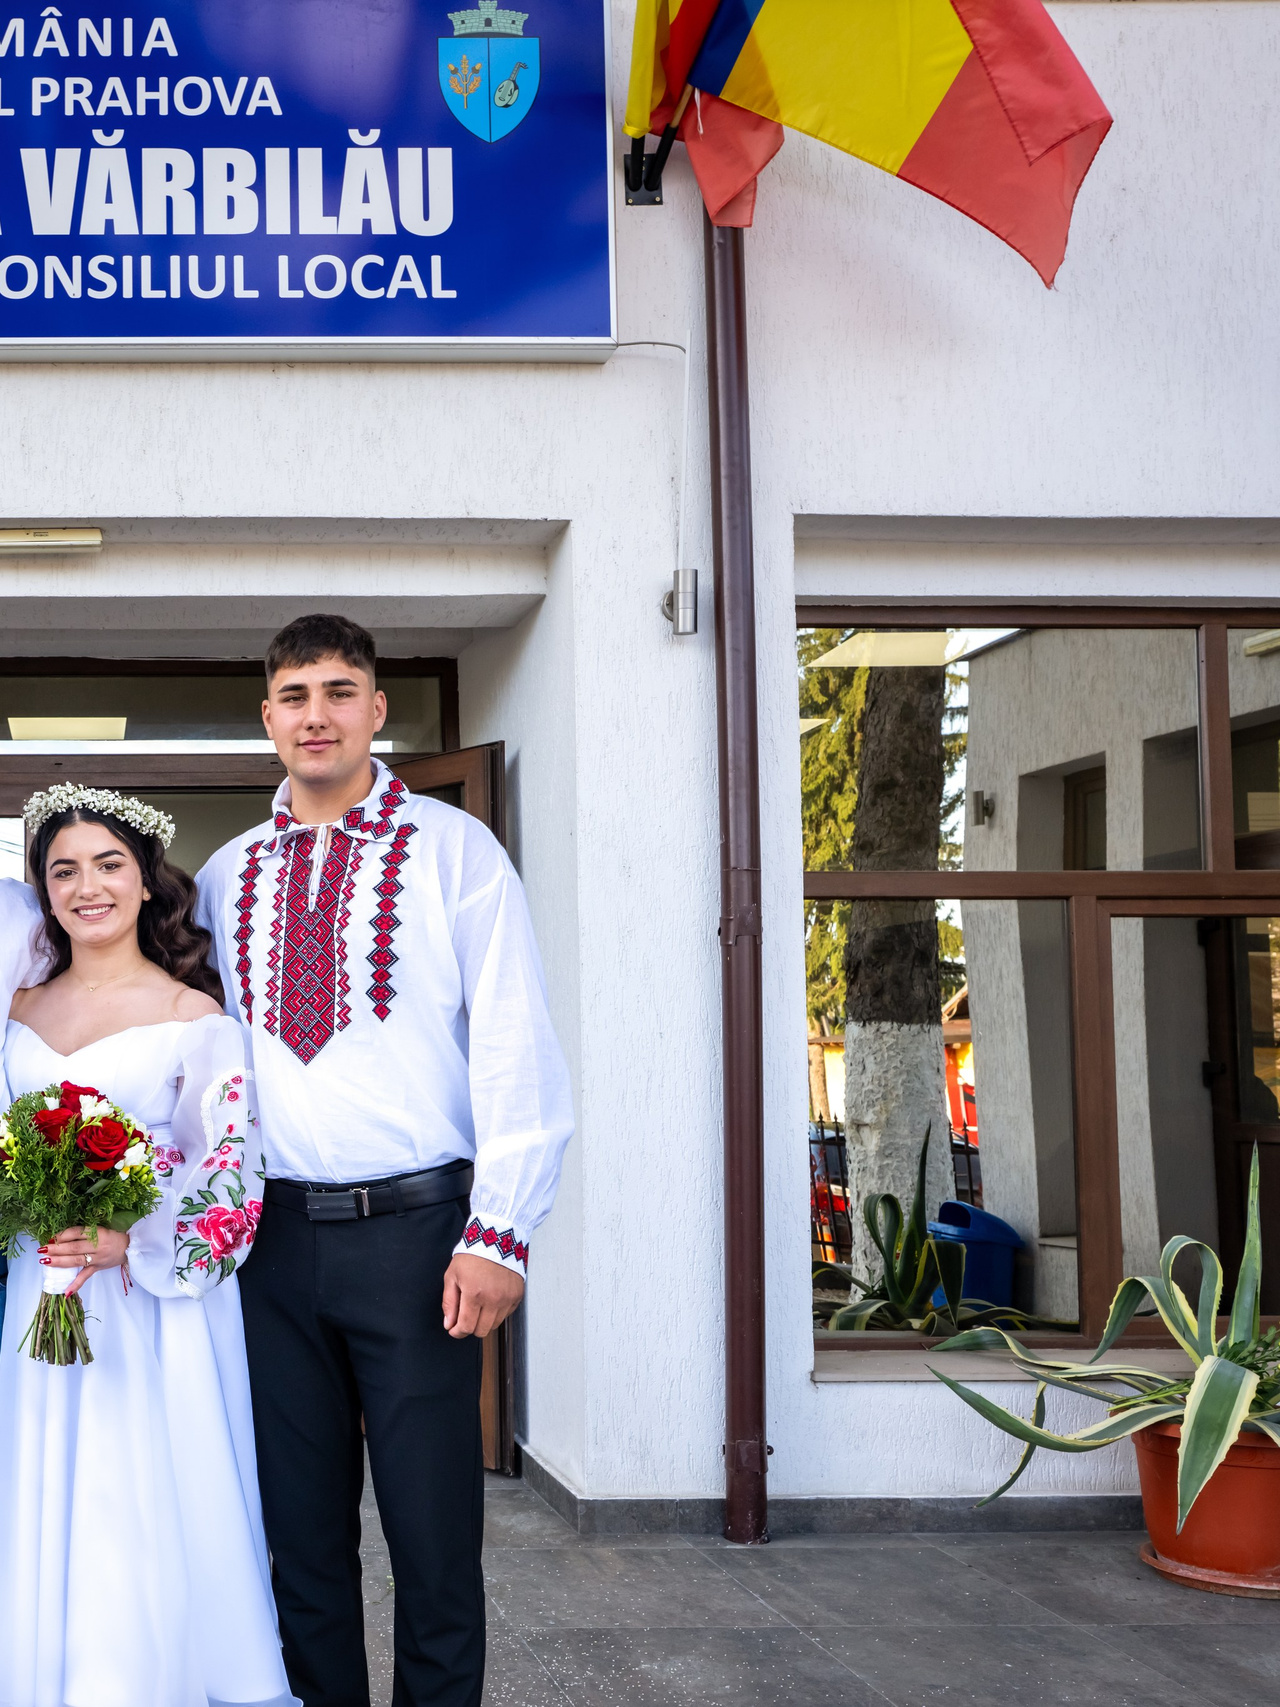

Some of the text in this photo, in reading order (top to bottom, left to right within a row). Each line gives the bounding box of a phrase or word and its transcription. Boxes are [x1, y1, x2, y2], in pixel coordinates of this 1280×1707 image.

[31, 76, 283, 117] PRAHOVA
[19, 128, 454, 237] VĂRBILĂU
[277, 254, 457, 299] LOCAL
